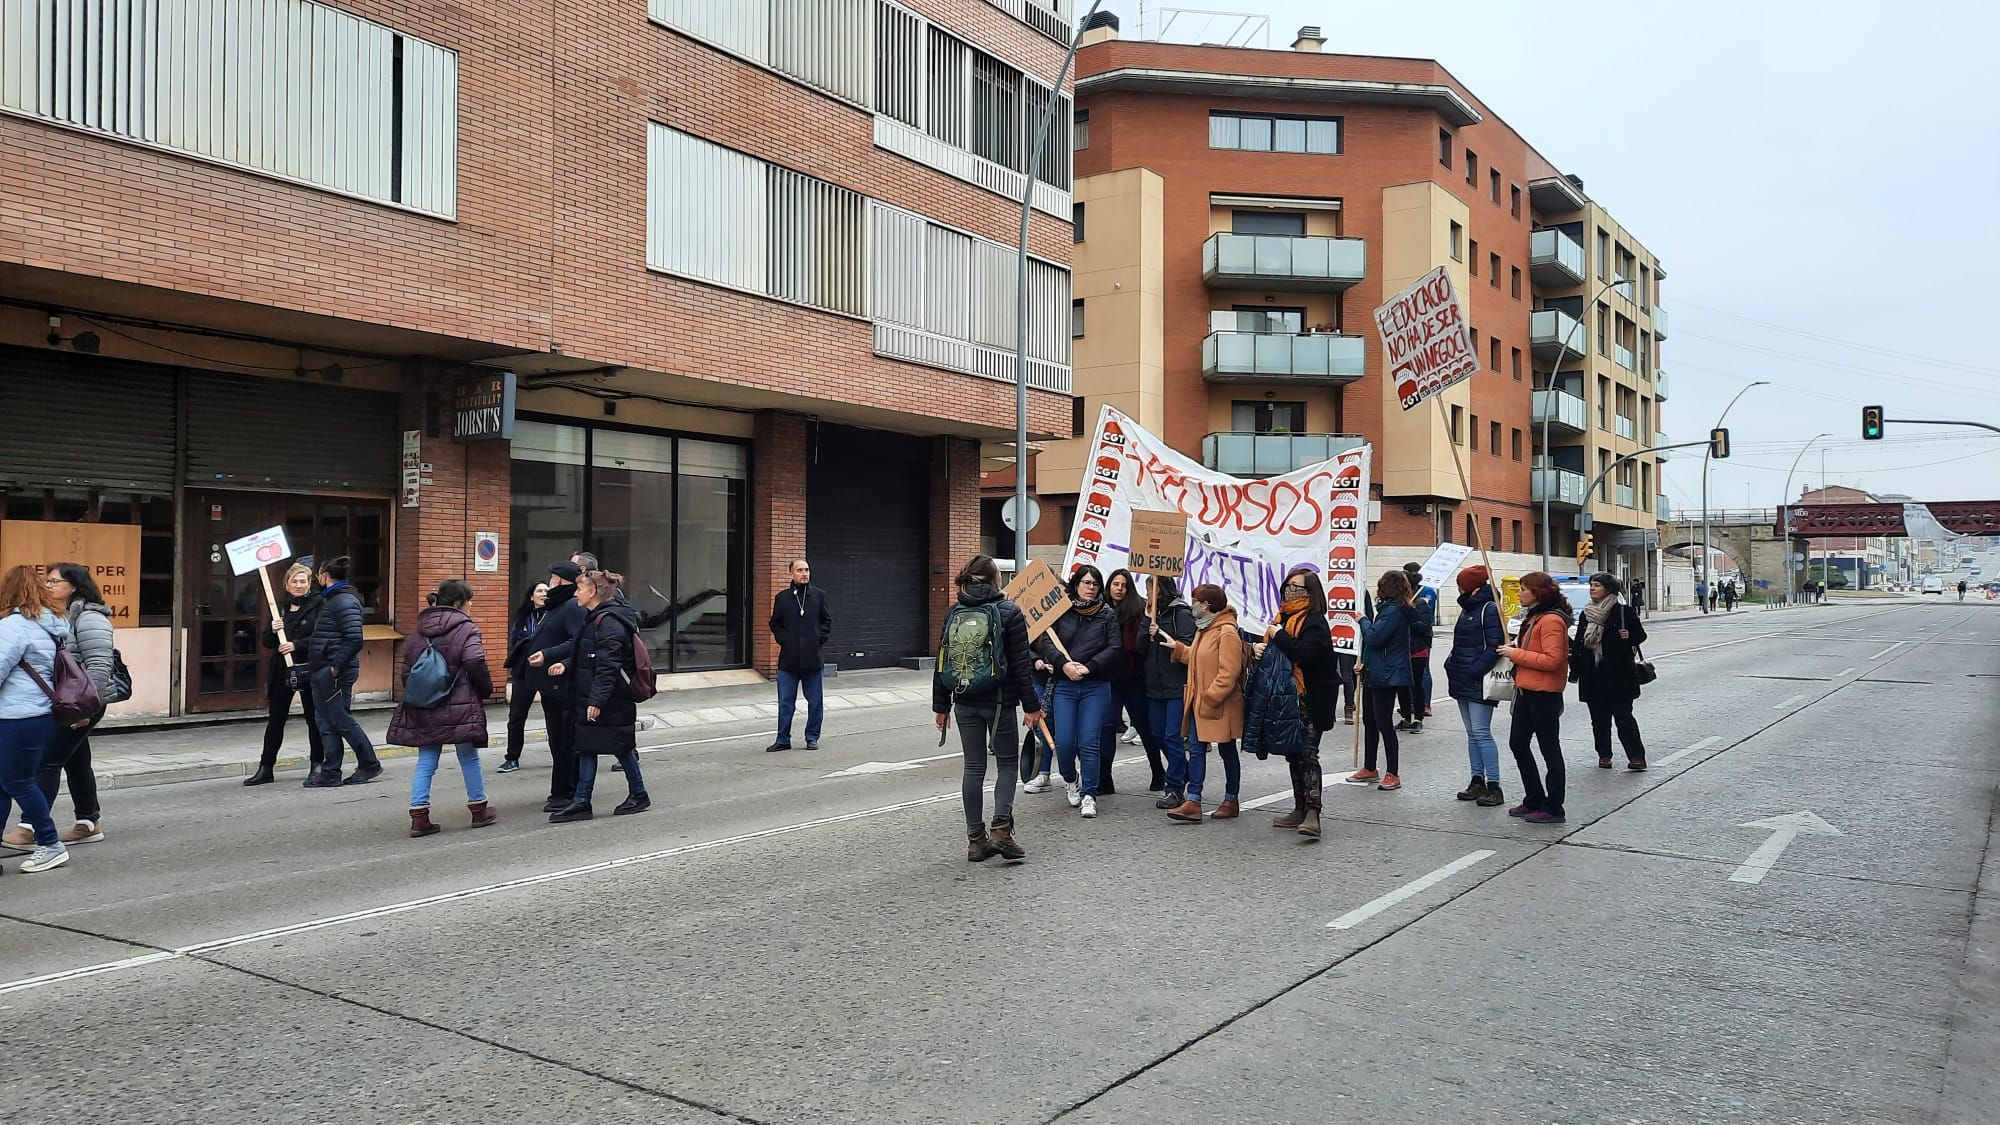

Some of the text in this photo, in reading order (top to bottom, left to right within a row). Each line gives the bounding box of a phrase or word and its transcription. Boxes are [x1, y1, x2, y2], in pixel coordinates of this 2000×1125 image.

[1388, 304, 1461, 364] NO HA DE SER
[1410, 352, 1428, 378] UN
[1402, 391, 1420, 408] CGT
[454, 407, 501, 436] JORSU'S
[1103, 432, 1125, 444] CGT
[1095, 466, 1118, 478] CGT
[1333, 477, 1360, 487] CGT
[1087, 503, 1110, 516] CGT
[1331, 517, 1357, 528] CGT
[1078, 538, 1100, 551] CGT
[1130, 552, 1183, 573] NO ESFORÇ
[1330, 558, 1356, 569] CGT
[96, 566, 125, 576] PER
[1029, 607, 1043, 621] EL
[1040, 586, 1063, 611] CAMP
[1329, 599, 1354, 609] CGT
